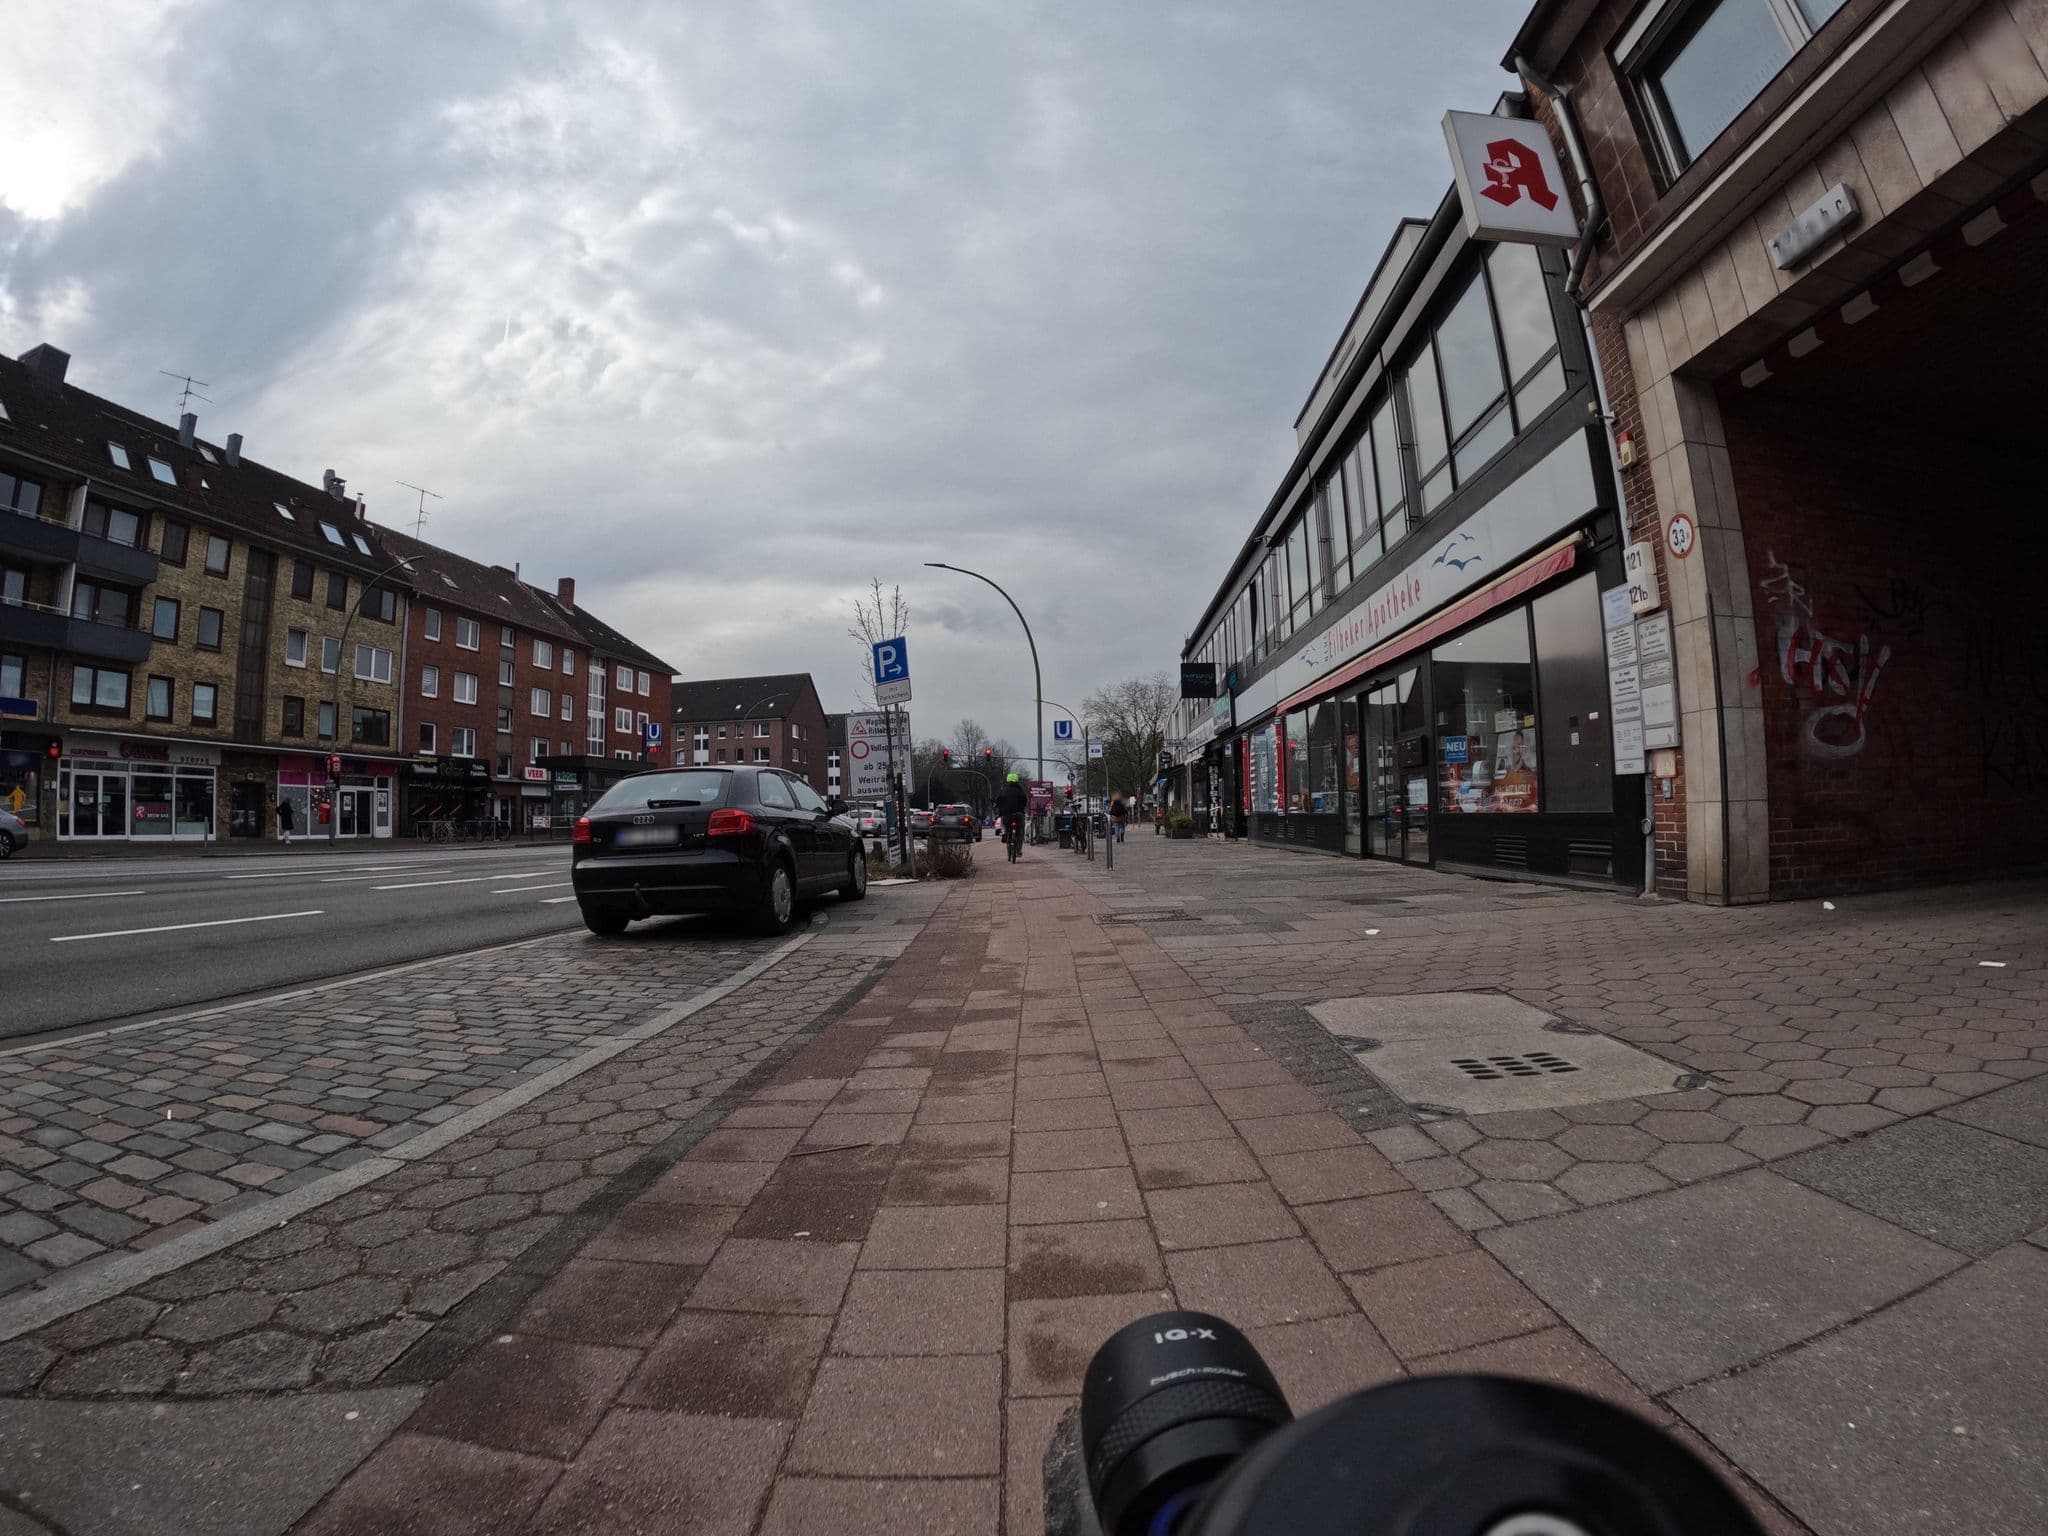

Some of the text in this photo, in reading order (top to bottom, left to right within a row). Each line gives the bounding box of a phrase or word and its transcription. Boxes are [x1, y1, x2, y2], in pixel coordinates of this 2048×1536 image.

[1626, 550, 1642, 571] 121
[1628, 583, 1649, 606] 121b
[1328, 573, 1421, 659] Eilbeker Apotheke
[878, 645, 897, 678] P
[879, 692, 909, 701] Parkschein
[648, 723, 660, 739] U
[1055, 721, 1071, 738] U
[1446, 741, 1466, 752] NEU
[527, 768, 544, 779] VEER
[863, 763, 874, 771] ab
